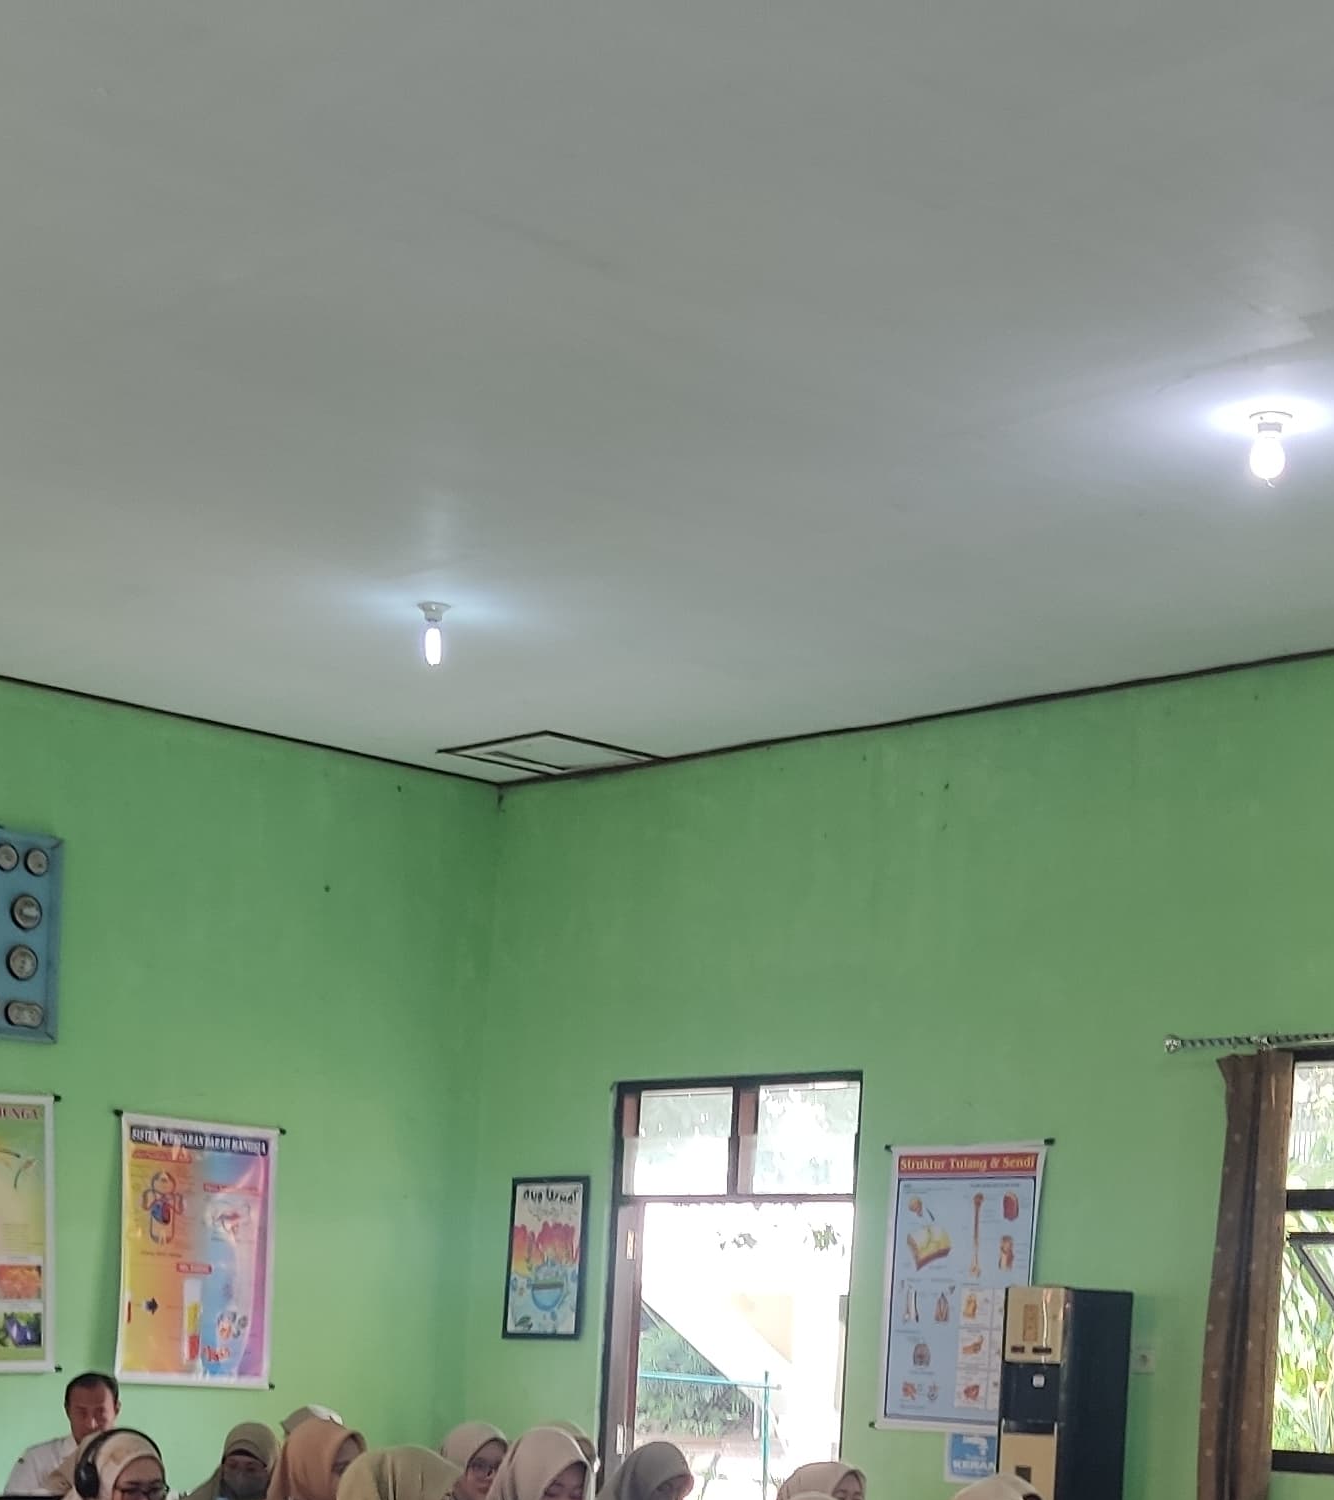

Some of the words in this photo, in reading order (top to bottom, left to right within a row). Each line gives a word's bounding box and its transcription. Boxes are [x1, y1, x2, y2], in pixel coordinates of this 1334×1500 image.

[900, 1157, 946, 1170] Struktur
[950, 1157, 987, 1172] Tulang
[990, 1157, 1000, 1169] &
[1003, 1156, 1035, 1169] Sendi
